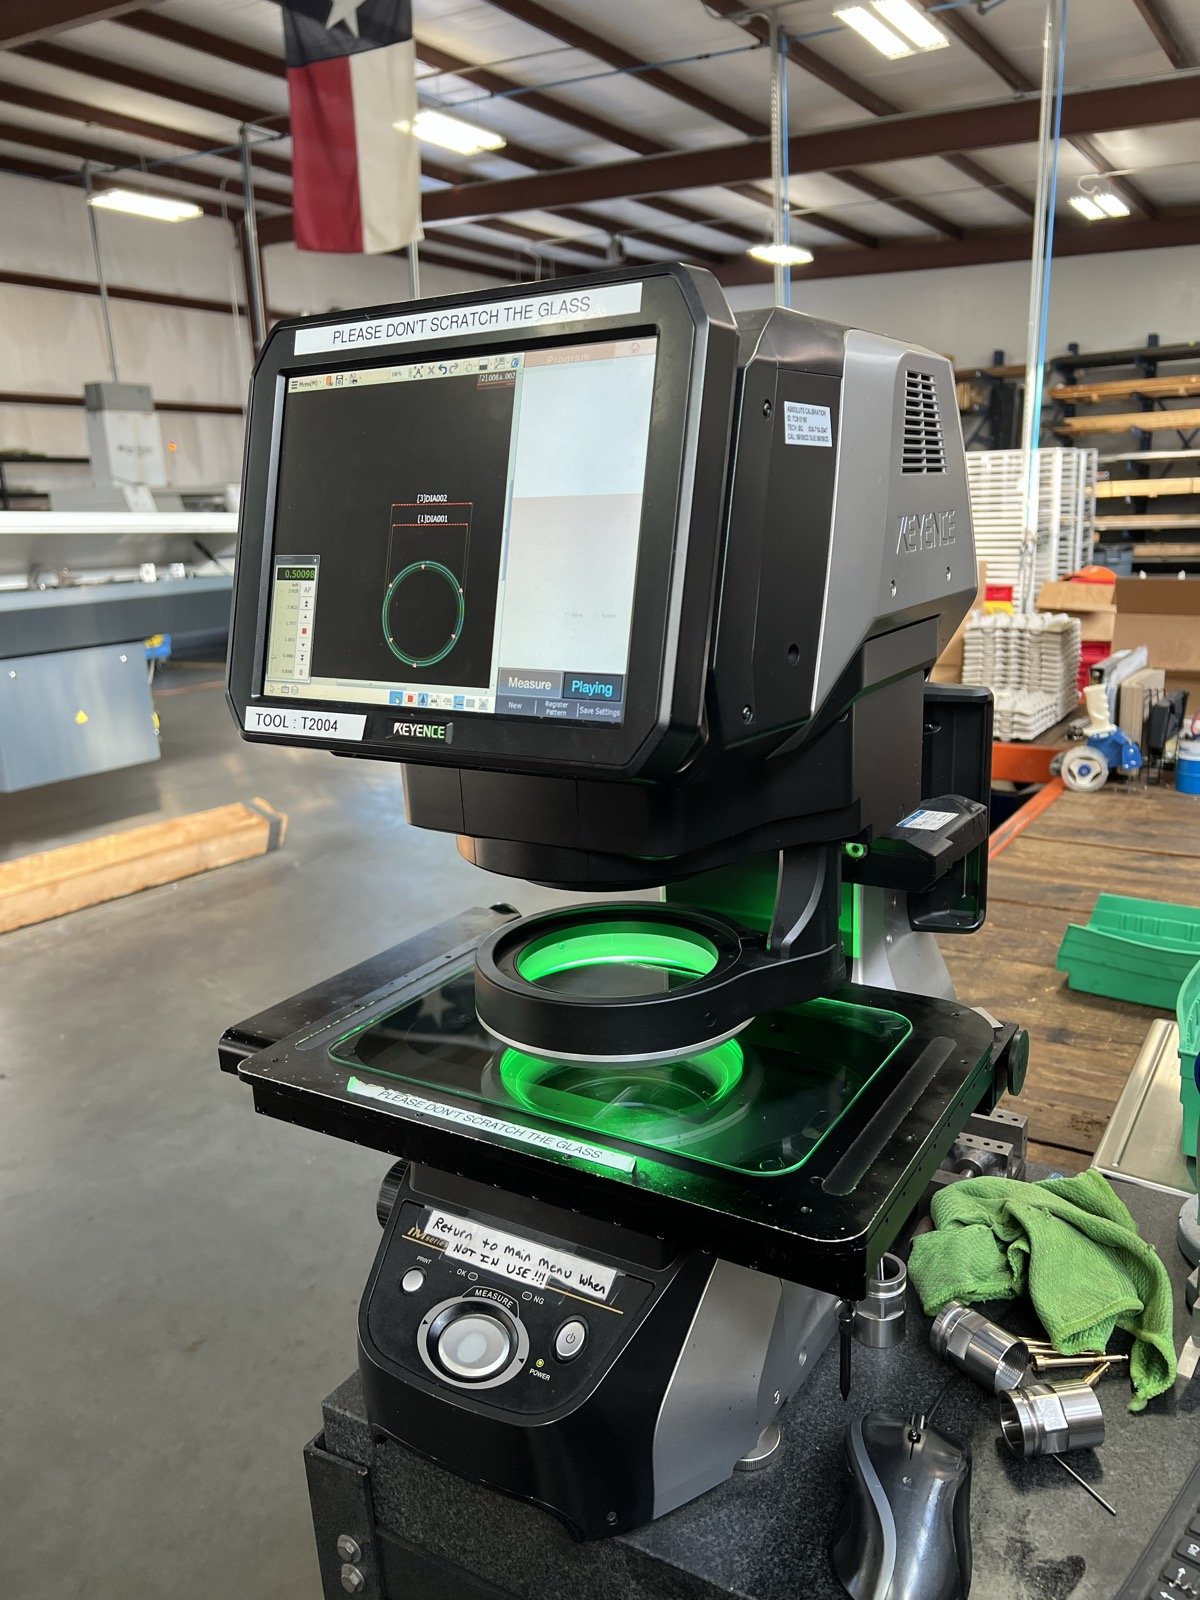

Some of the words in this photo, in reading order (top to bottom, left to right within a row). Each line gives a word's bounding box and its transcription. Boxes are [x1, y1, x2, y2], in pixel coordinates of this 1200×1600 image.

[333, 324, 383, 345] PLEASE
[386, 318, 427, 338] DON'T
[430, 310, 499, 332] SCRATCH
[504, 305, 532, 323] THE
[538, 296, 591, 317] GLASS
[547, 353, 590, 365] Program
[416, 494, 448, 503] [3]DIA002
[417, 514, 448, 523] [1]DIA001
[896, 510, 956, 554] KEYENCE
[284, 568, 315, 579] 0.50098
[508, 676, 552, 691] Measure
[571, 680, 613, 697] Playing
[508, 701, 522, 709] New
[545, 700, 569, 709] Register
[546, 708, 567, 717] Pattern
[580, 706, 594, 715] Save
[595, 707, 621, 718] Settings
[255, 712, 289, 729] TOOL
[301, 716, 338, 732] T2004
[393, 721, 446, 739] KEYENCE
[378, 1089, 424, 1110] PLEASE
[426, 1103, 461, 1120] DON'T
[462, 1113, 525, 1138] SCRATCH
[528, 1131, 554, 1146] THE
[555, 1139, 603, 1160] GLASS
[432, 1216, 473, 1241] Return
[482, 1238, 499, 1251] to
[416, 1255, 432, 1265] PRINT
[453, 1243, 477, 1258] NOT
[480, 1253, 500, 1267] IN
[456, 1268, 468, 1277] OK
[474, 1288, 514, 1309] MEASURE
[533, 1295, 545, 1305] NG
[529, 1367, 551, 1382] POWER
